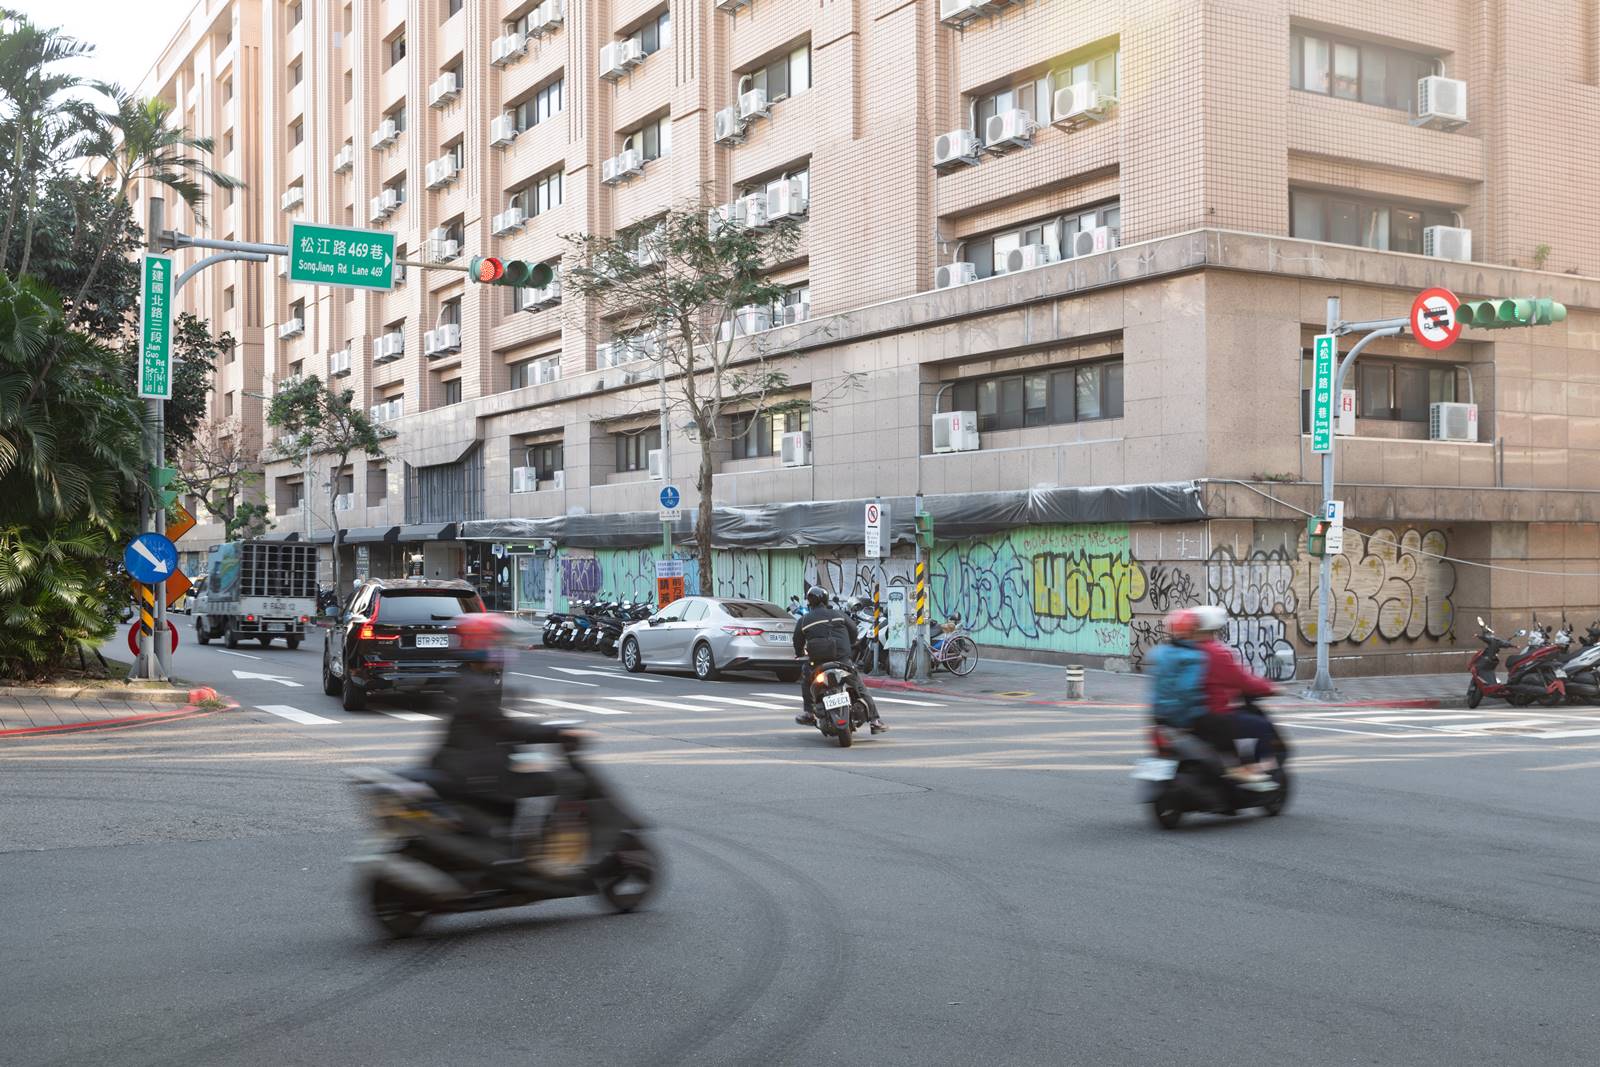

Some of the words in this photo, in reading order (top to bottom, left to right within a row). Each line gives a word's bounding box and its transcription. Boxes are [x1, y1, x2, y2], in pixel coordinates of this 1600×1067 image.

[301, 236, 383, 260] 松江路469巷
[351, 264, 369, 276] Lane
[370, 266, 384, 277] 469
[151, 270, 163, 343] 建國北路三段
[145, 350, 160, 359] Guo
[1318, 348, 1329, 418] 松江路469巷
[1328, 505, 1335, 517] P
